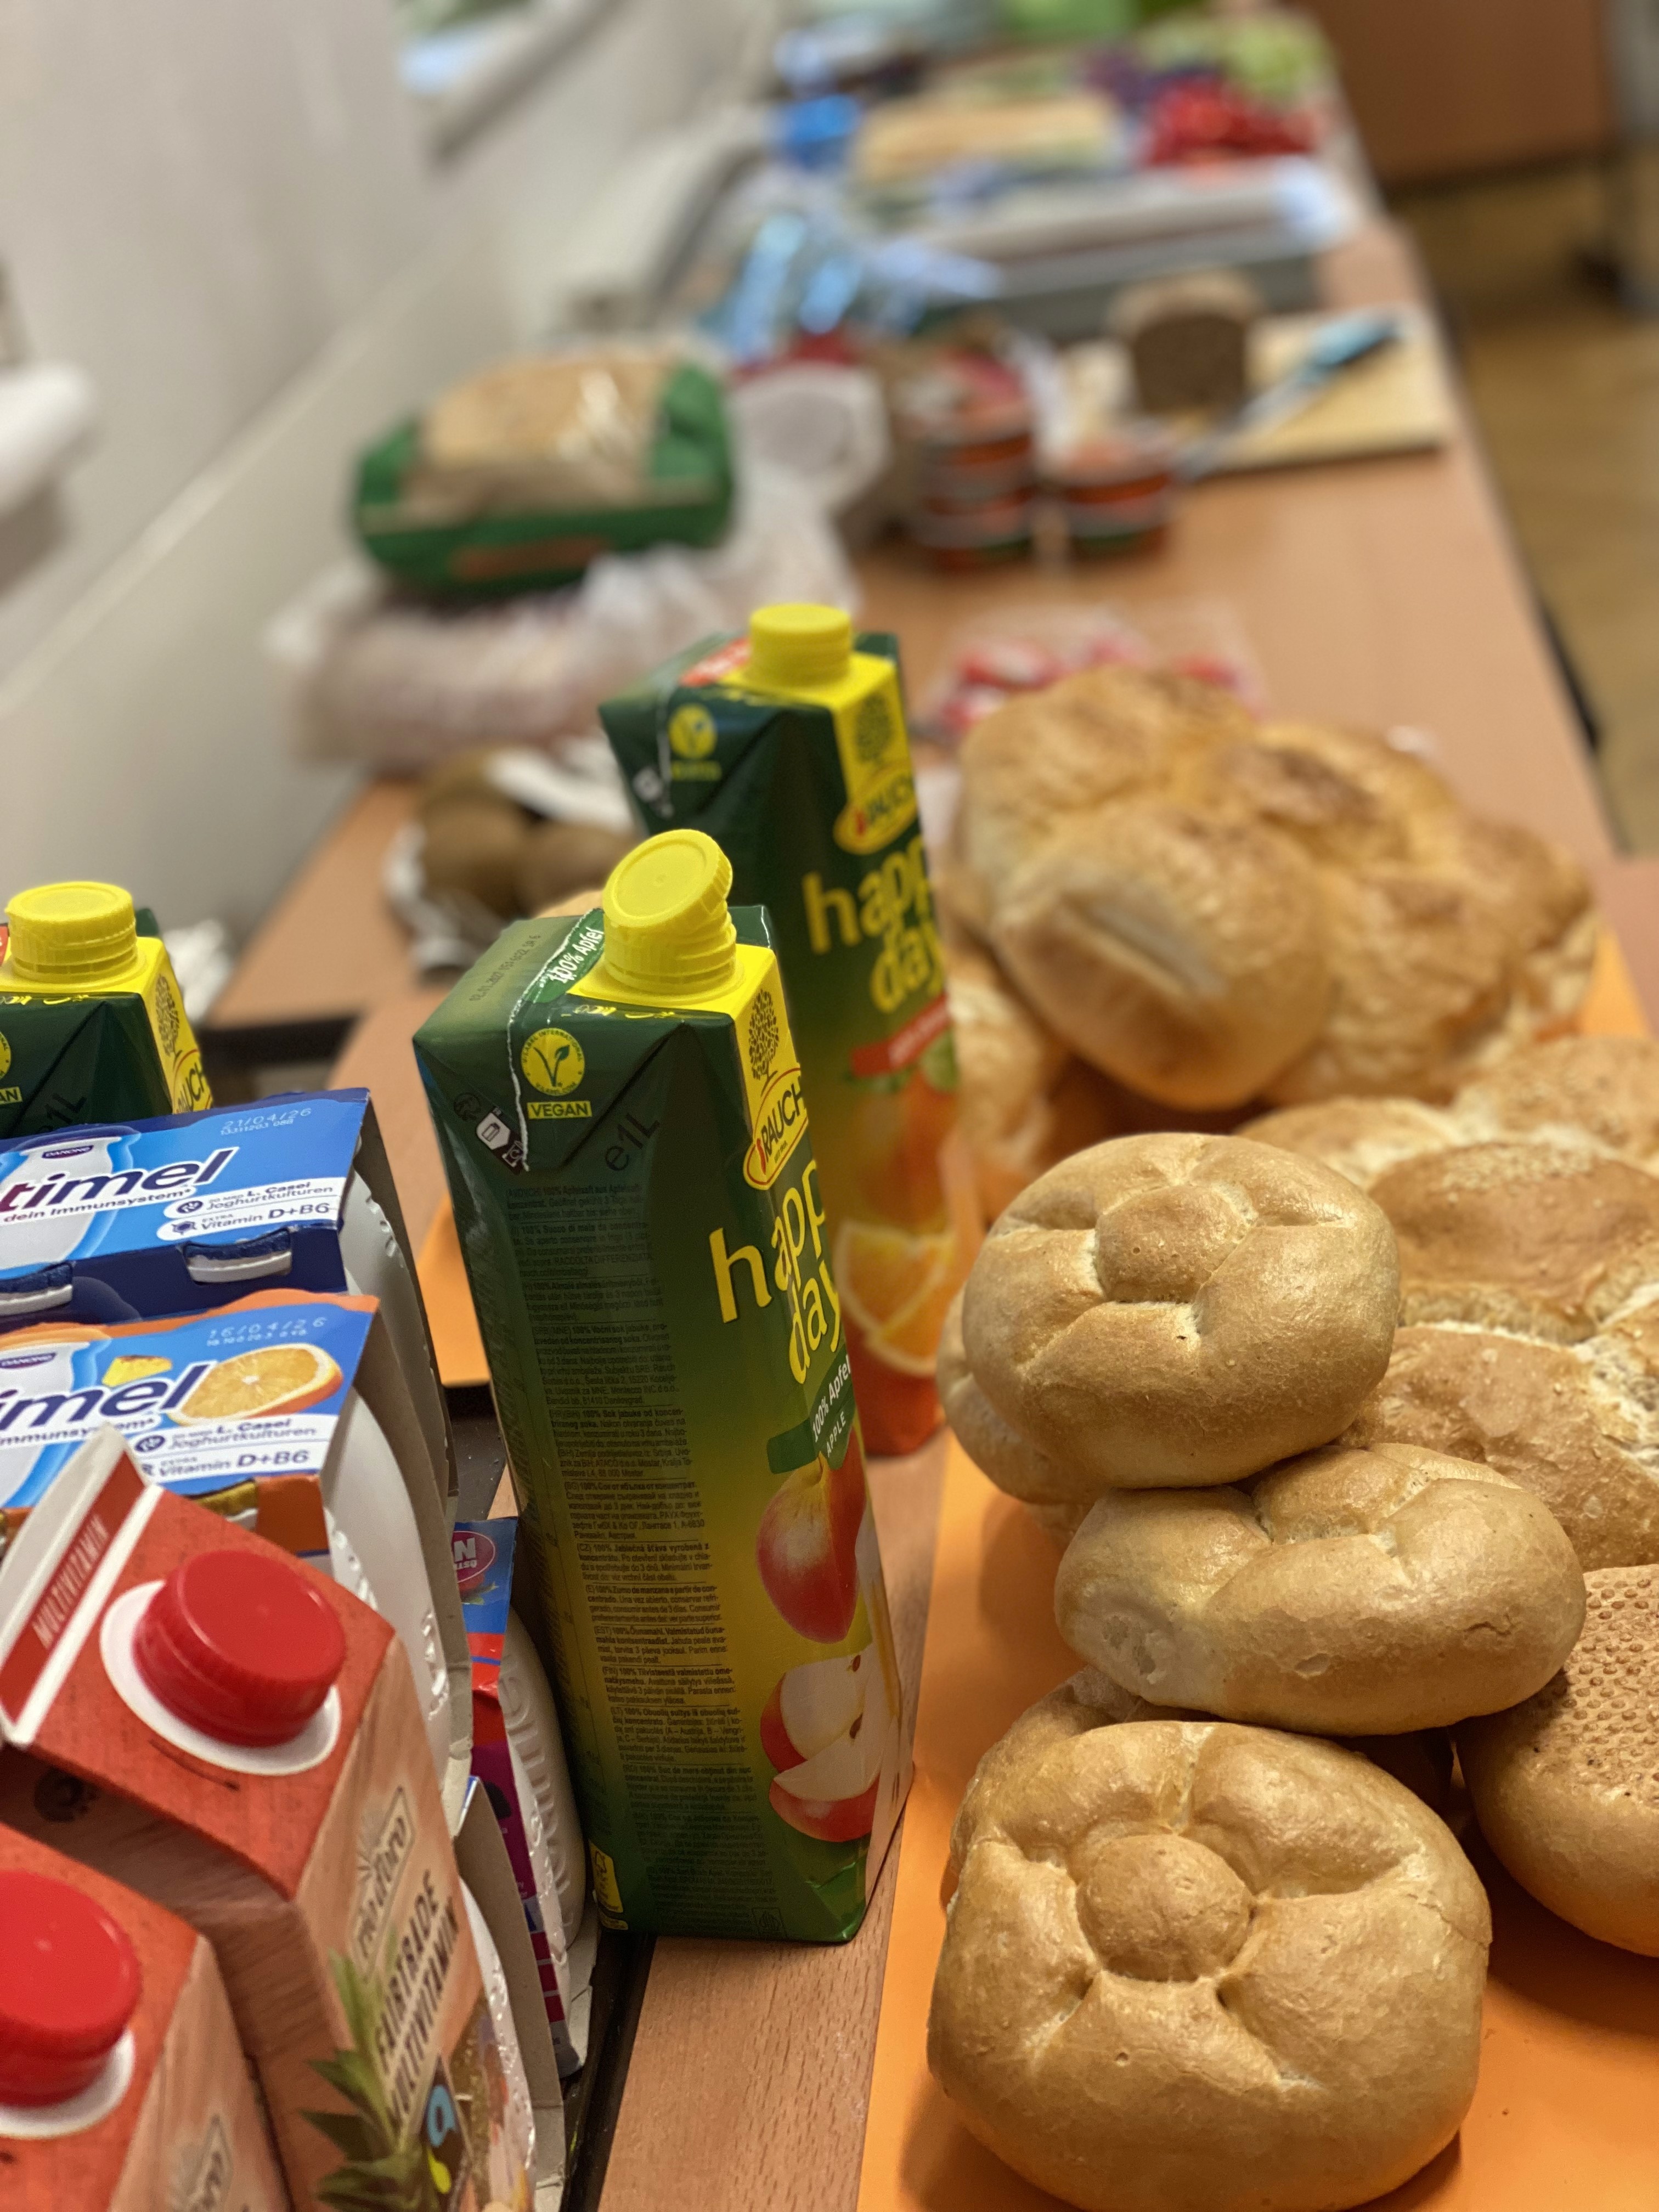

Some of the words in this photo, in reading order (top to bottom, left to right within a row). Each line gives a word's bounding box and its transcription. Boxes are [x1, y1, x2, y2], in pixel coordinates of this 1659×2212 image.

[548, 951, 584, 984] 100%
[571, 926, 605, 956] Apfel
[531, 1103, 589, 1118] VEGAN
[761, 1075, 803, 1163] RAUCH
[206, 1186, 333, 1210] Joghurtkulturen
[264, 1181, 311, 1194] Casei
[3, 1210, 46, 1223] dein
[201, 1214, 263, 1231] Vitamin
[268, 1202, 330, 1219] D+B6
[811, 1396, 830, 1444] 100%
[827, 1353, 851, 1403] Apfel
[826, 1410, 847, 1459] APPLE
[374, 1869, 439, 2076] FAIRTRADE
[385, 1896, 459, 2138] MULTIVITAMIN
